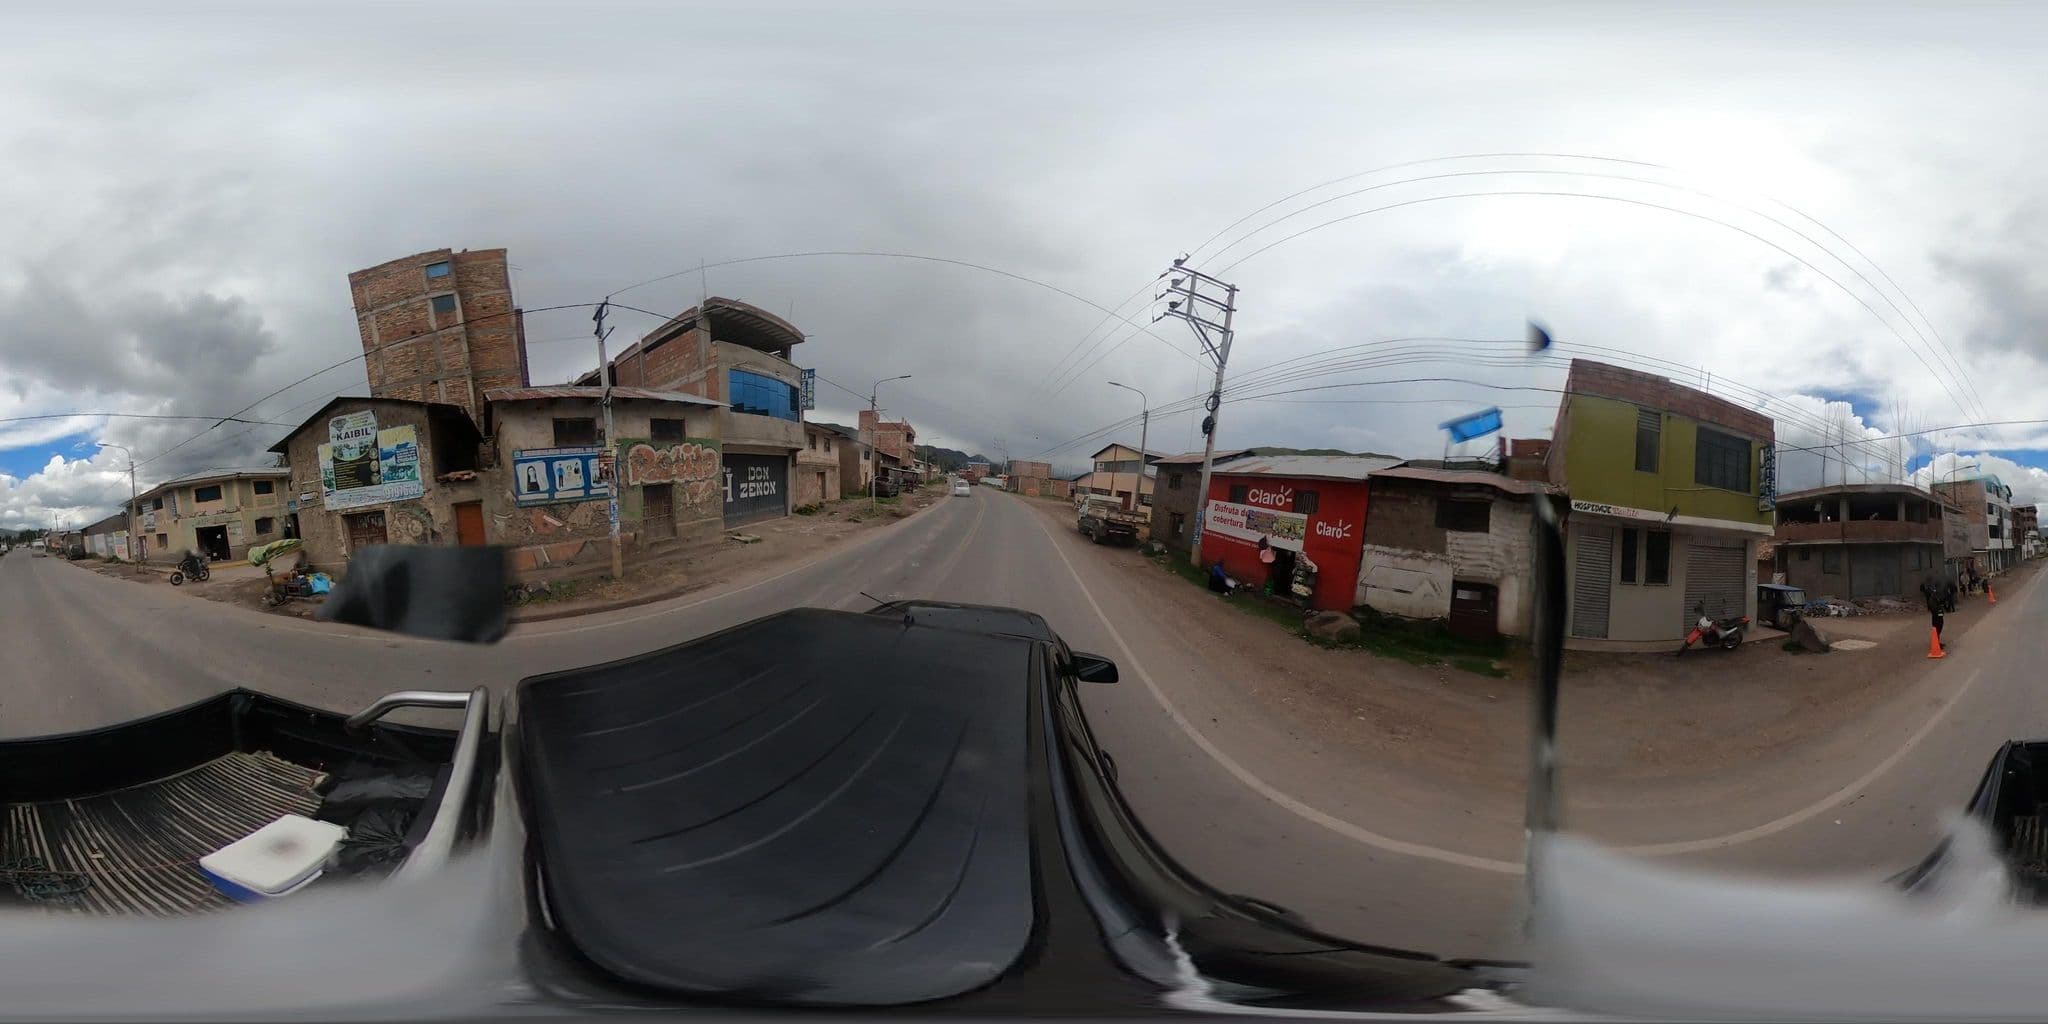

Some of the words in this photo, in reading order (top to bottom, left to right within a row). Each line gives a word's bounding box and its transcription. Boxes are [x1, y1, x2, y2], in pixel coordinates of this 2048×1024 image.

[748, 466, 769, 481] DON
[740, 481, 776, 498] ZENON
[1248, 487, 1287, 506] Claro
[1214, 503, 1240, 516] Disfruta
[1574, 501, 1612, 514] HOSPEDAJE
[1212, 514, 1244, 528] cobertura
[1316, 521, 1343, 539] Claro
